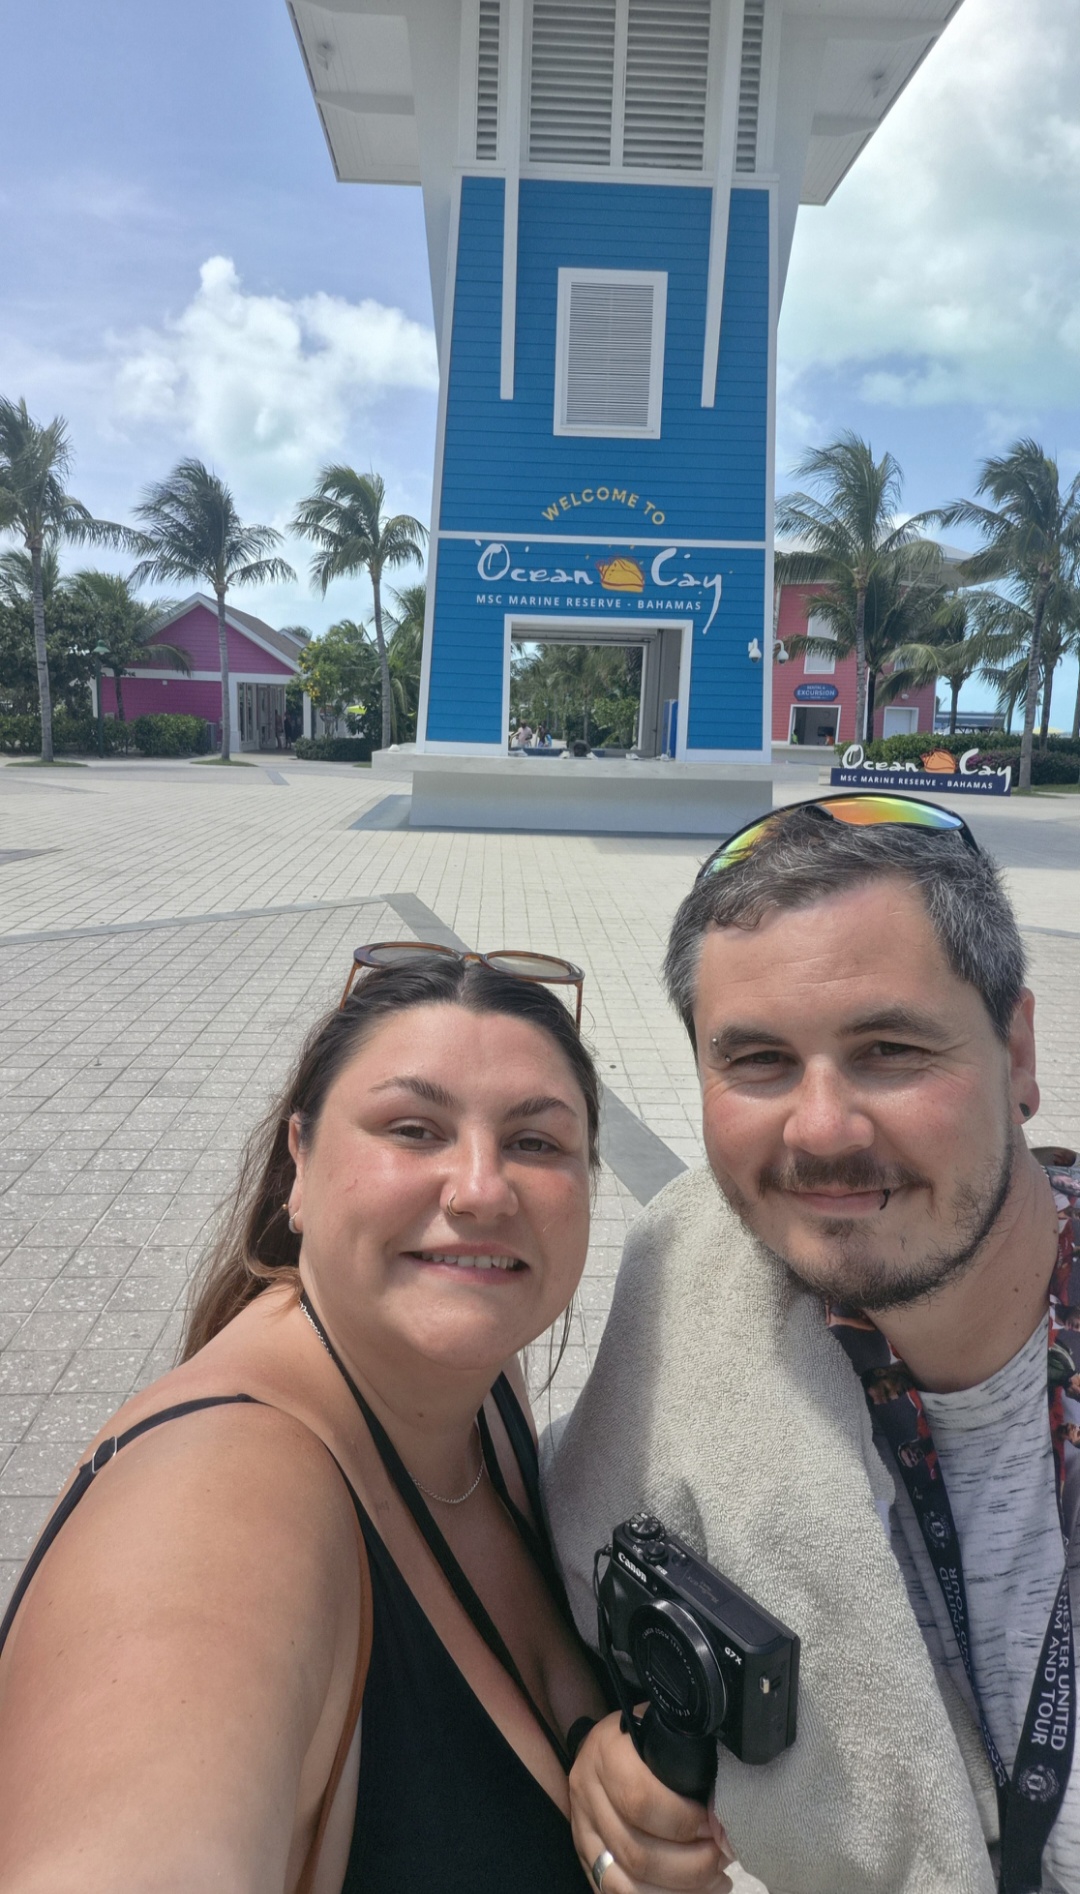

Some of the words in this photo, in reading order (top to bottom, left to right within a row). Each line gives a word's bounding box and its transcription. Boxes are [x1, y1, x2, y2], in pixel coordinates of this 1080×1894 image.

[541, 486, 640, 522] WELCOME
[643, 500, 666, 526] TO
[476, 542, 594, 585] Ocean
[650, 546, 723, 634] Cay
[476, 593, 503, 605] MSC
[508, 595, 561, 607] MARINE
[566, 597, 622, 609] RESERVE
[637, 599, 702, 611] BAHAMAS
[840, 774, 858, 783] MSC
[860, 775, 895, 785] MARINE
[898, 777, 937, 788] RESERVE
[946, 780, 994, 791] BAHAMAS
[842, 744, 919, 773] Ocean
[959, 748, 1012, 792] Cay
[617, 1551, 648, 1583] Canon
[939, 1566, 961, 1638] UNITED
[948, 1567, 964, 1622] TOUR
[1044, 1635, 1060, 1683] AND
[1030, 1689, 1056, 1746] TOUR
[1050, 1674, 1071, 1751] UNITED
